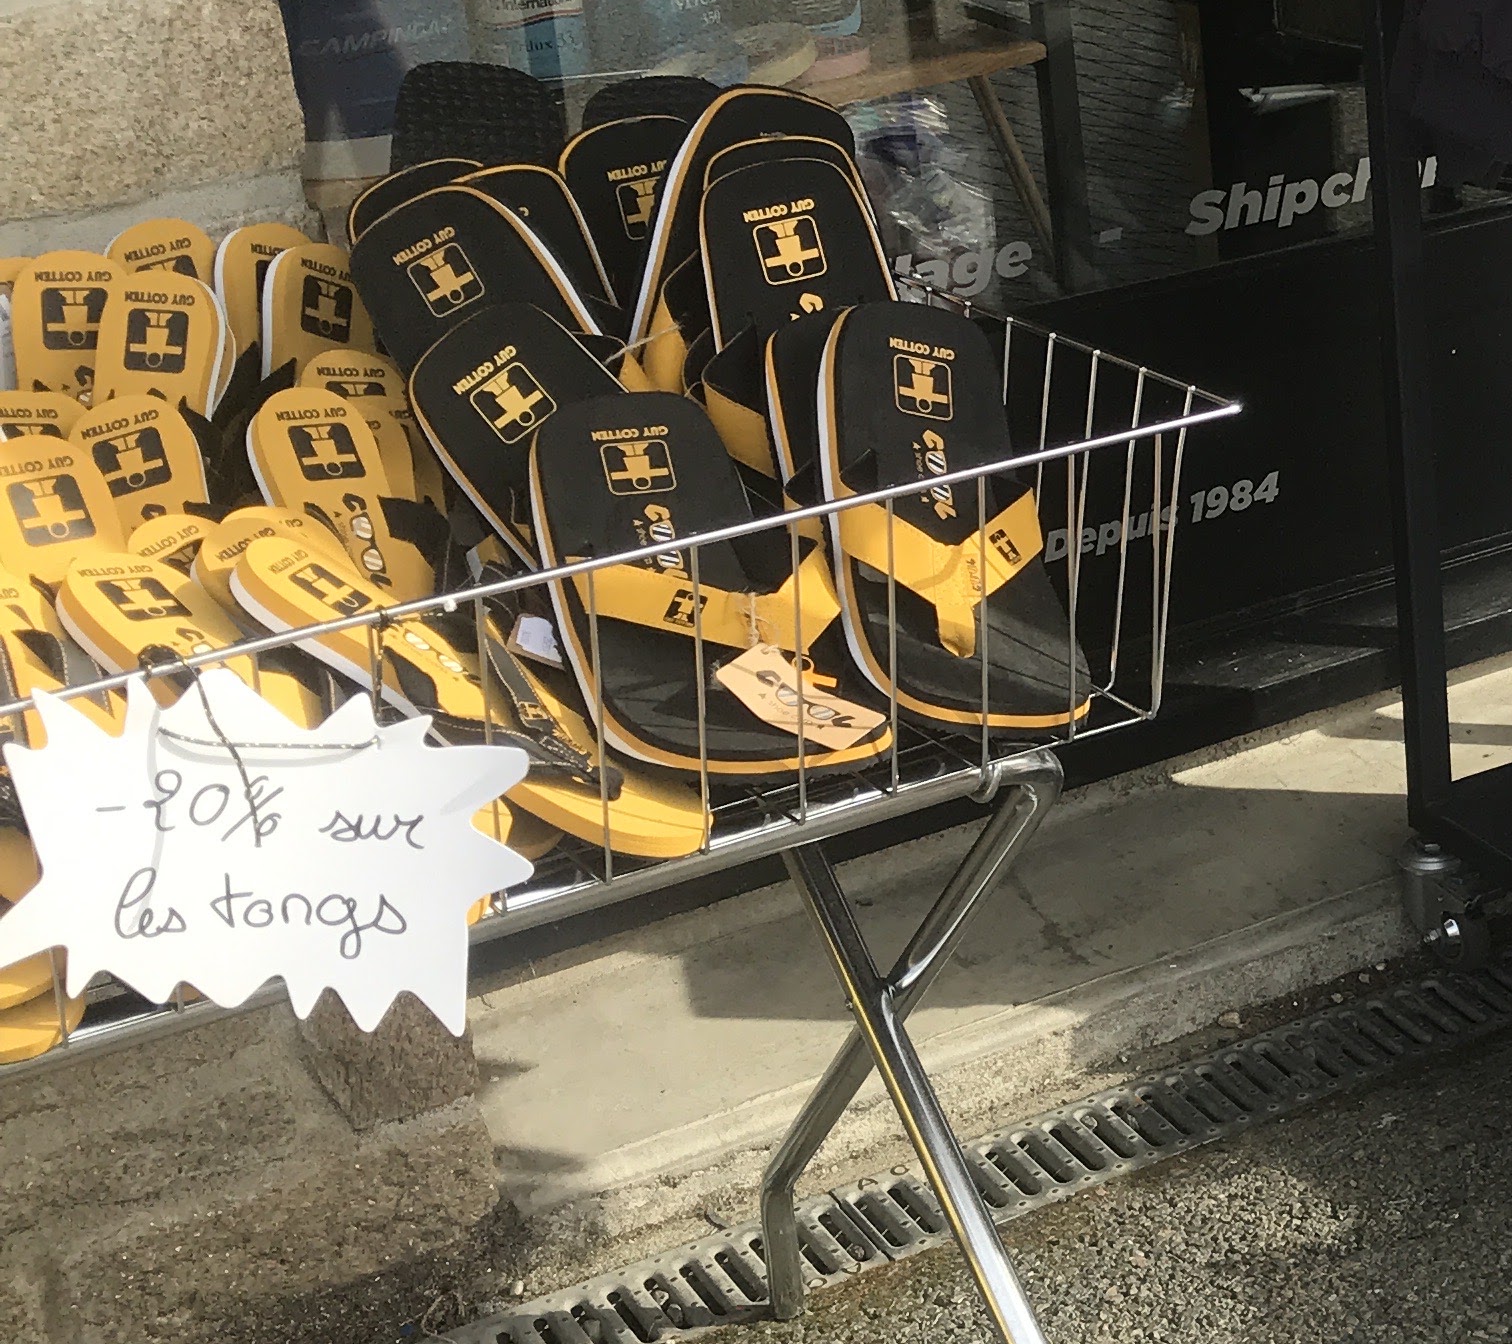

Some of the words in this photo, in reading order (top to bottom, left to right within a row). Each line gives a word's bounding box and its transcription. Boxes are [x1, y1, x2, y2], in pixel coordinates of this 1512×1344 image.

[606, 165, 649, 183] COTTEN
[791, 197, 816, 212] GUY
[742, 204, 789, 224] COTTEN
[433, 225, 456, 246] GUY
[124, 243, 168, 263] COTTEN
[170, 237, 192, 254] GUY
[391, 237, 434, 266] COTTEN
[86, 270, 113, 282] GUY
[300, 257, 337, 278] COTTEN
[34, 270, 82, 283] COTTEN
[124, 290, 169, 305] COTTEN
[171, 293, 196, 306] GUY
[889, 336, 931, 356] COTTEN
[932, 346, 956, 361] GUY
[494, 344, 518, 369] GUY
[316, 366, 360, 377] COTTEN
[363, 367, 386, 378] GUY
[451, 362, 496, 396] COTTEN
[36, 408, 59, 419] GUY
[133, 409, 160, 427] GUY
[275, 408, 321, 422] COTTEN
[322, 406, 347, 420] GUY
[80, 418, 131, 441] COTTEN
[590, 427, 639, 442] COTTEN
[643, 425, 669, 438] GUY
[48, 455, 75, 470] GUY
[1044, 503, 1180, 563] Depuis
[1189, 470, 1280, 523] 1984
[177, 524, 201, 542] GUY
[137, 536, 178, 559] COTTEN
[77, 565, 126, 578] COTTEN
[127, 564, 154, 574] GUY
[318, 809, 426, 850] sur
[114, 866, 188, 940] les
[209, 872, 408, 960] tongs
